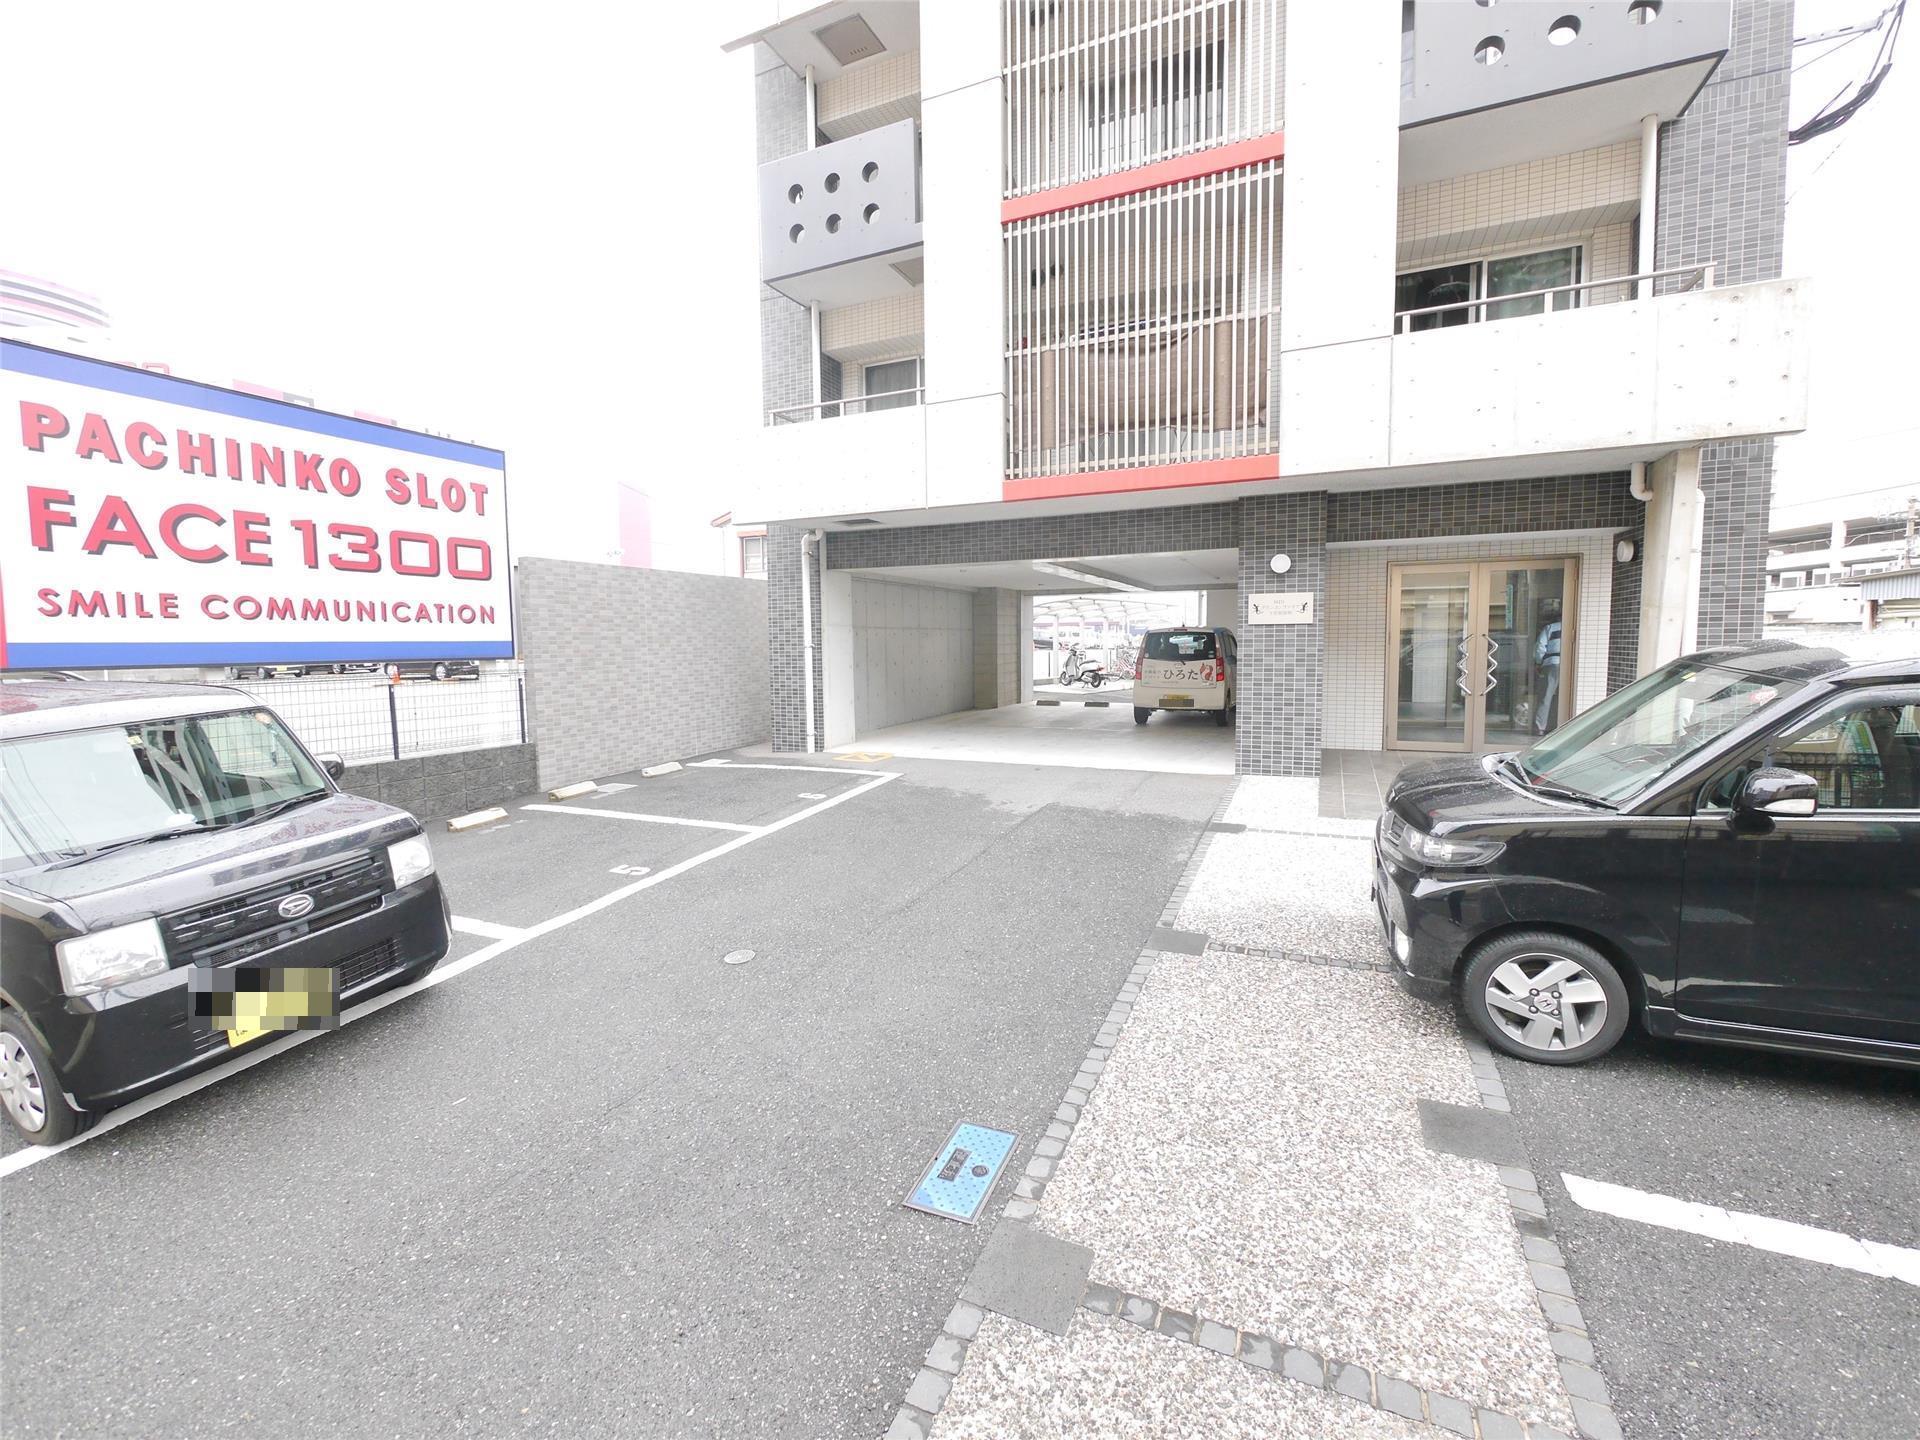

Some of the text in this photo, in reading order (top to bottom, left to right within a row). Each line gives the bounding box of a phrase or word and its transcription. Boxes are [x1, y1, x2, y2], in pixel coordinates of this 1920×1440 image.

[21, 401, 488, 515] PACHINKO SLOT
[27, 485, 492, 580] FACE 1300
[37, 587, 496, 625] SMILE COMMUNICATION
[1163, 668, 1199, 681] ひろた
[608, 864, 651, 876] 5
